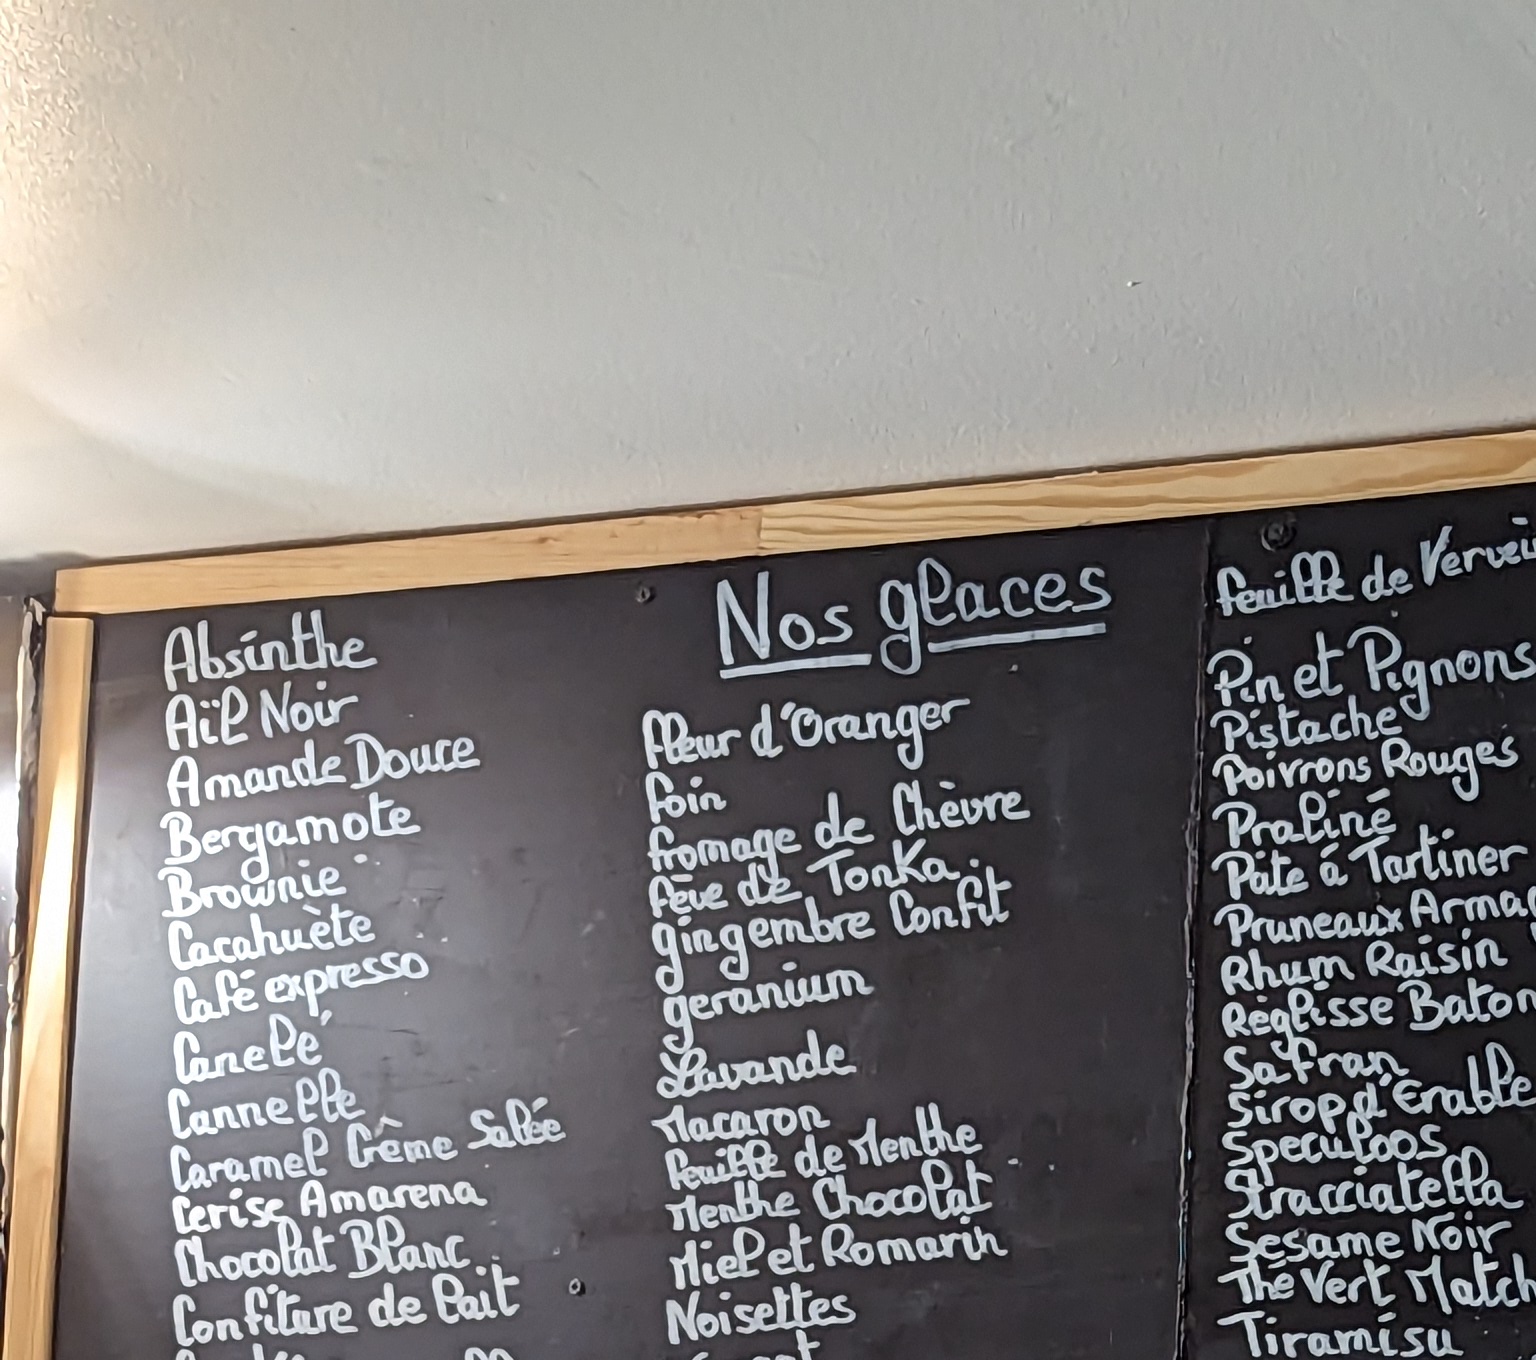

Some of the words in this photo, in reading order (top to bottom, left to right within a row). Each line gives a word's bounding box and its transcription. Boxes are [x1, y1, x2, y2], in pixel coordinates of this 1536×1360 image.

[1361, 554, 1414, 601] de
[165, 610, 378, 691] Absinthe
[716, 571, 854, 666] Nos
[879, 557, 1112, 676] glaces
[1206, 636, 1285, 707] Pin
[1293, 631, 1345, 698] et
[260, 682, 358, 737] Noir
[1210, 695, 1403, 753] Pistache
[167, 741, 346, 807] Amande
[345, 733, 480, 789] Douce
[1381, 735, 1520, 802] Rouges
[161, 793, 421, 885] Bergamote
[814, 791, 875, 849] de
[892, 780, 1030, 836] Chèvre
[1212, 787, 1398, 849] Praliné
[158, 860, 347, 917] Brownie
[1348, 823, 1529, 885] Tartiner
[889, 858, 1012, 936] Confit
[1214, 903, 1404, 947] Pruneaux
[168, 904, 376, 970] Cacahuète
[1221, 949, 1356, 997] Rhum
[1366, 928, 1508, 978] Raisin
[173, 970, 259, 1026] Café
[265, 952, 429, 1016] expresso
[1221, 980, 1393, 1058] Réglisse
[173, 1011, 333, 1085] Canelé
[657, 1030, 857, 1099] Lavande
[1224, 1036, 1410, 1089] Safran
[168, 1067, 365, 1139] Cannelle
[651, 1103, 831, 1144] Macaron
[1227, 1089, 1346, 1133] Sirop
[169, 1128, 329, 1192] Caramel
[468, 1097, 566, 1150] Salée
[794, 1134, 847, 1179] de
[848, 1102, 983, 1166] Menthe
[1222, 1113, 1449, 1186] Speculoos
[172, 1189, 284, 1234] Cerise
[301, 1180, 487, 1218] Amarena
[666, 1180, 800, 1232] Menthe
[812, 1159, 993, 1221] Chocolat
[1225, 1145, 1524, 1219] Stracciatella
[174, 1217, 335, 1287] Chocolat
[340, 1217, 470, 1279] Blanc
[669, 1226, 765, 1290] Miel
[767, 1223, 815, 1276] et
[821, 1214, 1008, 1268] Romarin
[1412, 1211, 1512, 1254] Noir
[172, 1284, 358, 1348] Confiture
[368, 1283, 427, 1328] de
[665, 1282, 857, 1345] Noisettes
[1218, 1258, 1296, 1304] Thé
[1301, 1259, 1397, 1306] Vert
[1217, 1311, 1464, 1358] Tiramisu
